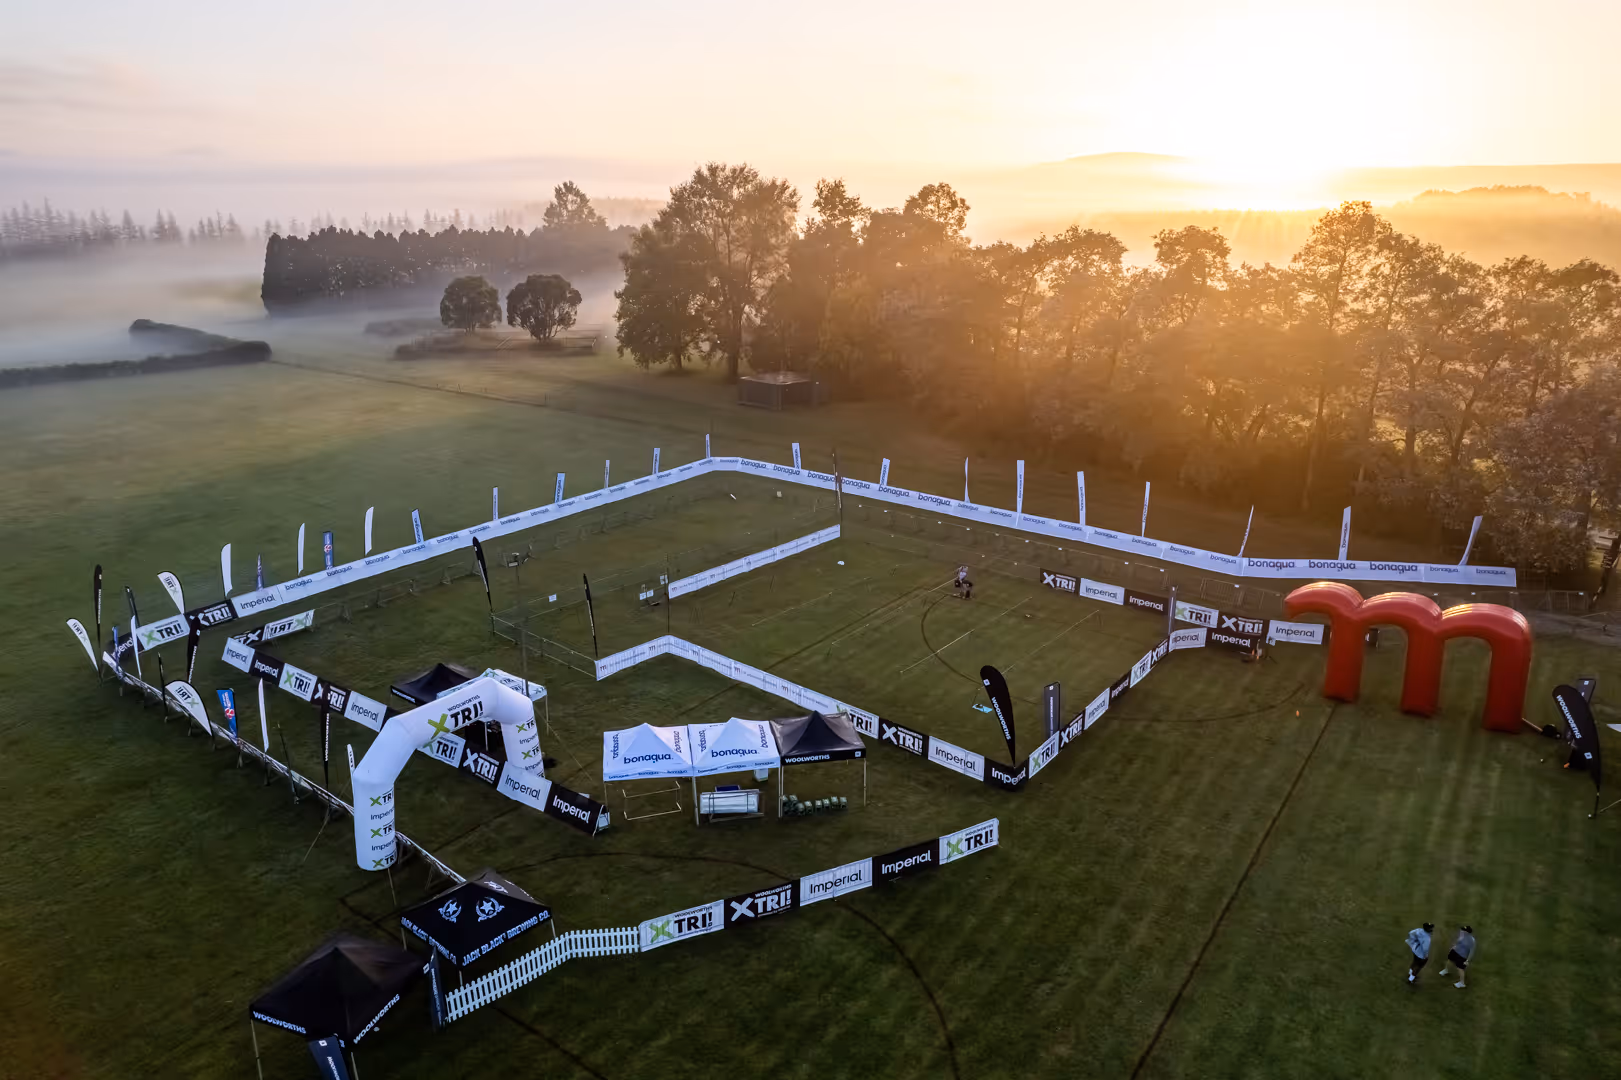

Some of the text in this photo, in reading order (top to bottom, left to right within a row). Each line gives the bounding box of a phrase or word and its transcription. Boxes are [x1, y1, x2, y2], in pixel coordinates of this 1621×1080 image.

[1248, 558, 1295, 571] bonaqua
[1308, 560, 1356, 572] bonaqua
[1370, 562, 1418, 574] bonaqua
[992, 696, 1012, 740] WOOLWORTHS
[1556, 694, 1582, 739] WOOLWORTHS
[624, 754, 671, 764] bonaqua
[712, 748, 758, 758] bonaqua
[784, 754, 830, 764] WOOLWORTHS
[882, 850, 932, 874] Imperial
[810, 870, 862, 894] Imperial
[730, 889, 792, 922] XTRI!
[462, 948, 481, 966] JACK
[507, 916, 539, 940] BREWING
[253, 1011, 306, 1034] WOOLWORTHS
[354, 994, 400, 1044] WOOLWORTHS
